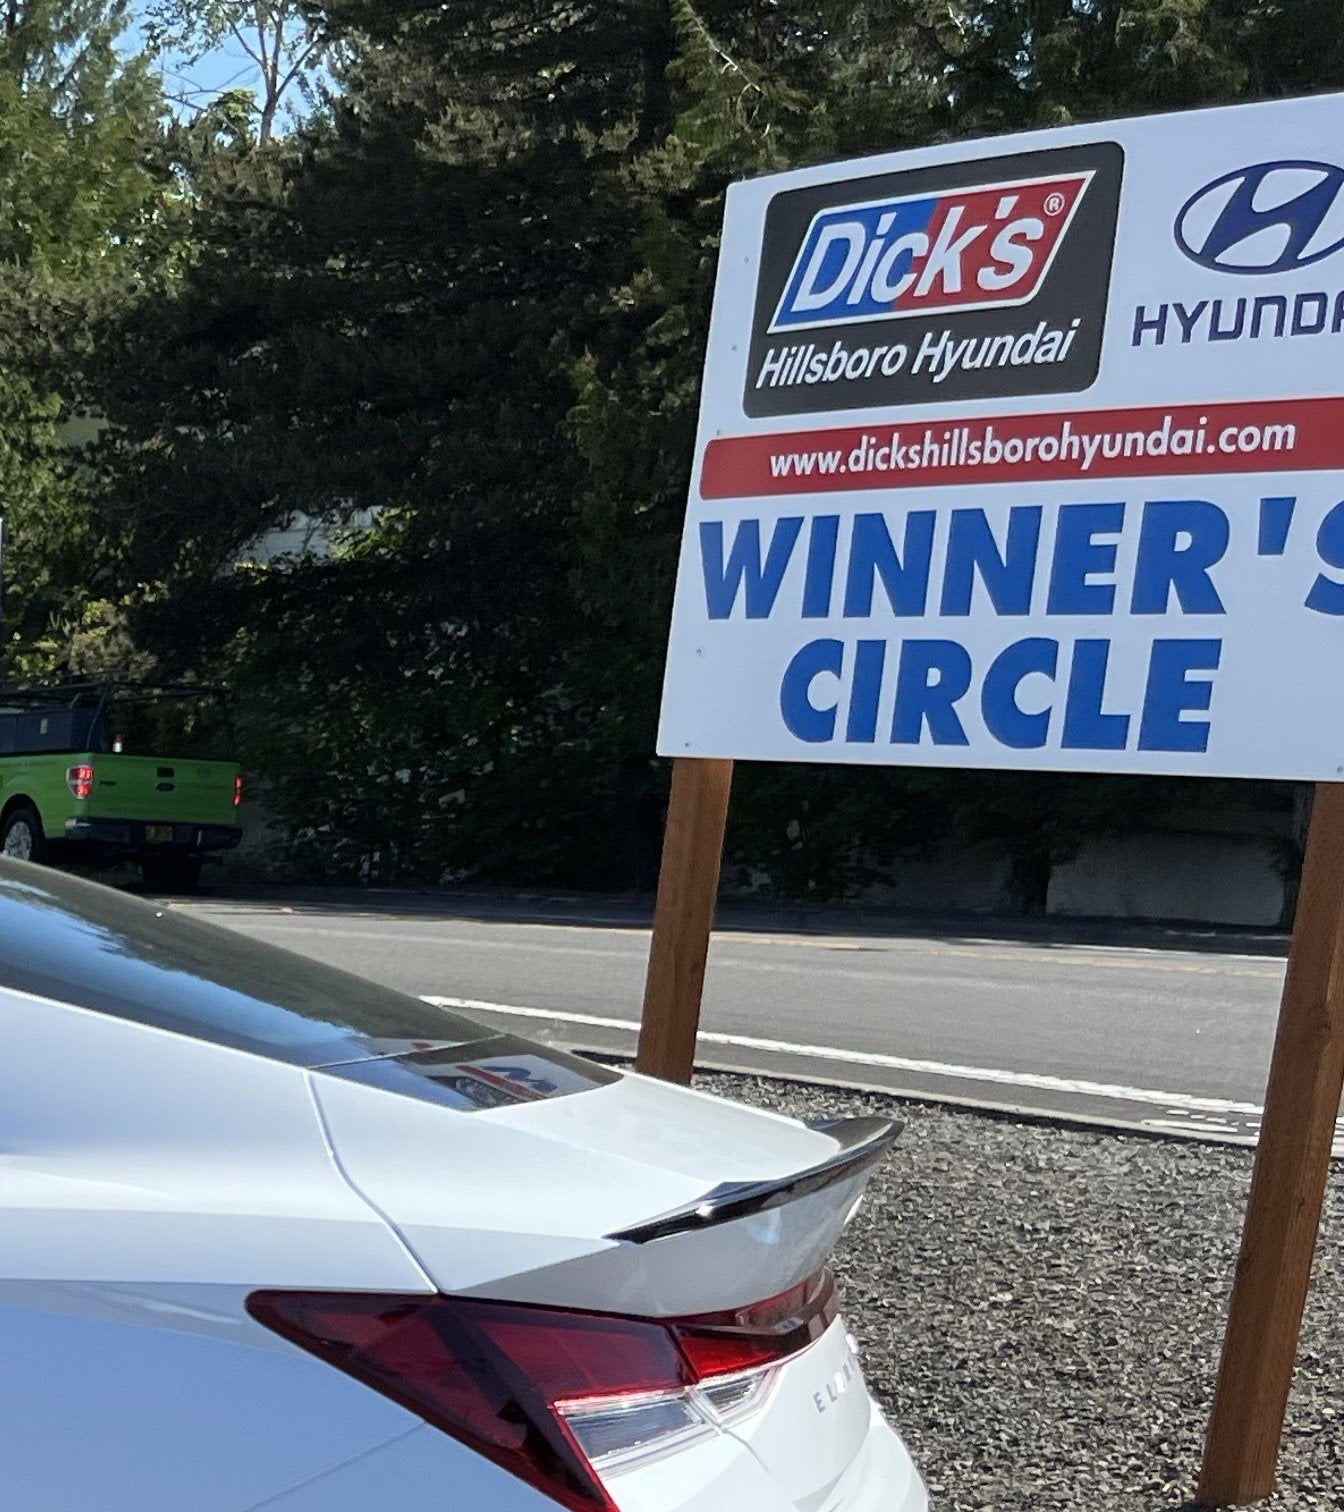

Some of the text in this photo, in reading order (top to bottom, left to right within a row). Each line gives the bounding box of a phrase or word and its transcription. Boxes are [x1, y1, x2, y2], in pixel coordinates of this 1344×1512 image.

[790, 196, 1045, 312] Dick's
[755, 318, 1082, 389] Hillsboro Hyundai
[769, 416, 1297, 477] www.dickshillsborohyundai.com
[779, 637, 1223, 753] CIRCLE
